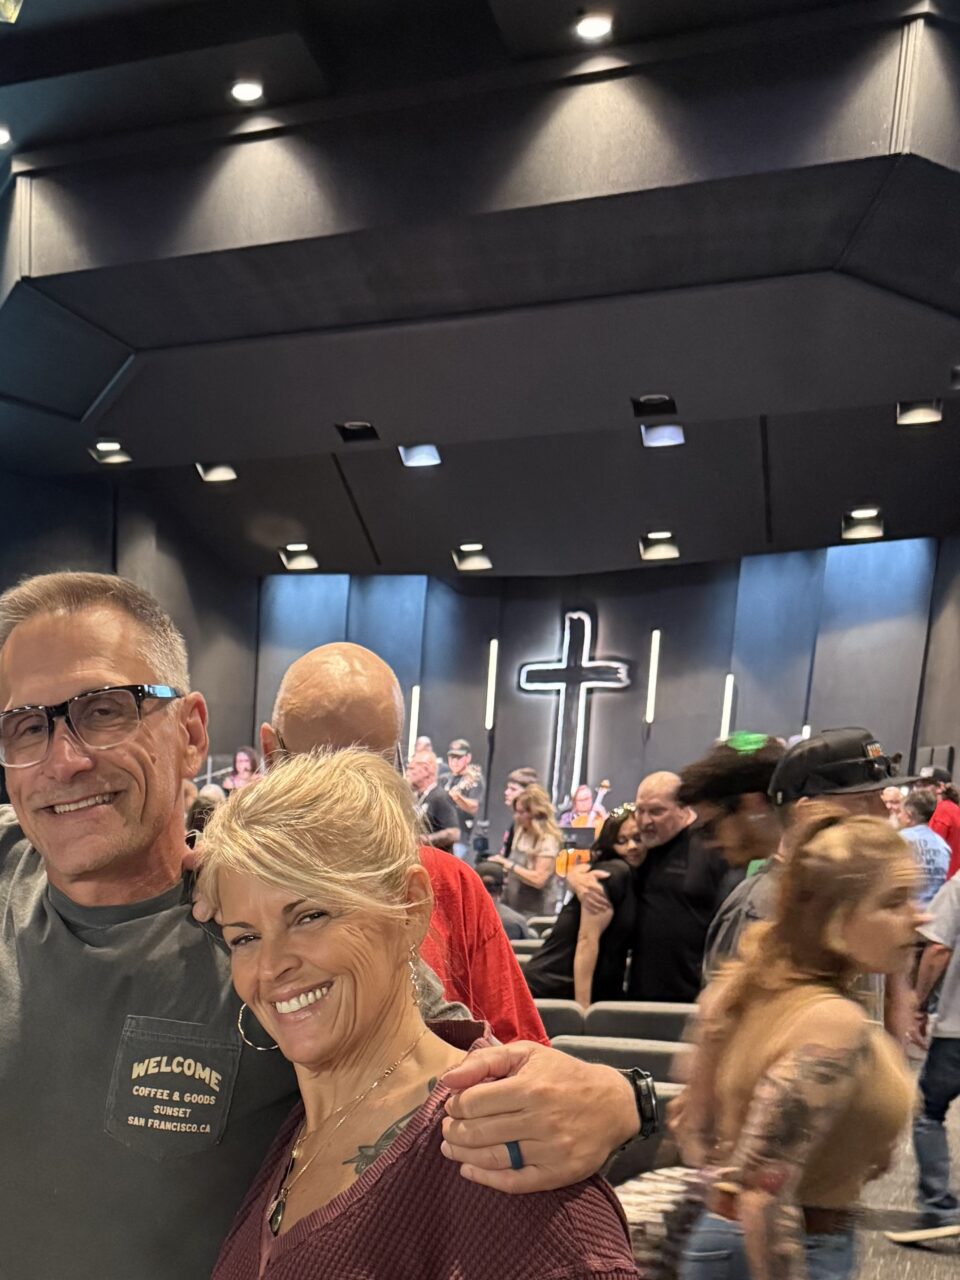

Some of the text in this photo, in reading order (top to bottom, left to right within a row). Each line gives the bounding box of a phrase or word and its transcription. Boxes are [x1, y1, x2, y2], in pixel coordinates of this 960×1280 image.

[131, 1056, 222, 1092] WELCOME
[132, 1085, 216, 1105] COFFEE & GOODS
[153, 1104, 192, 1118] SUNSET
[127, 1116, 145, 1126] SAN
